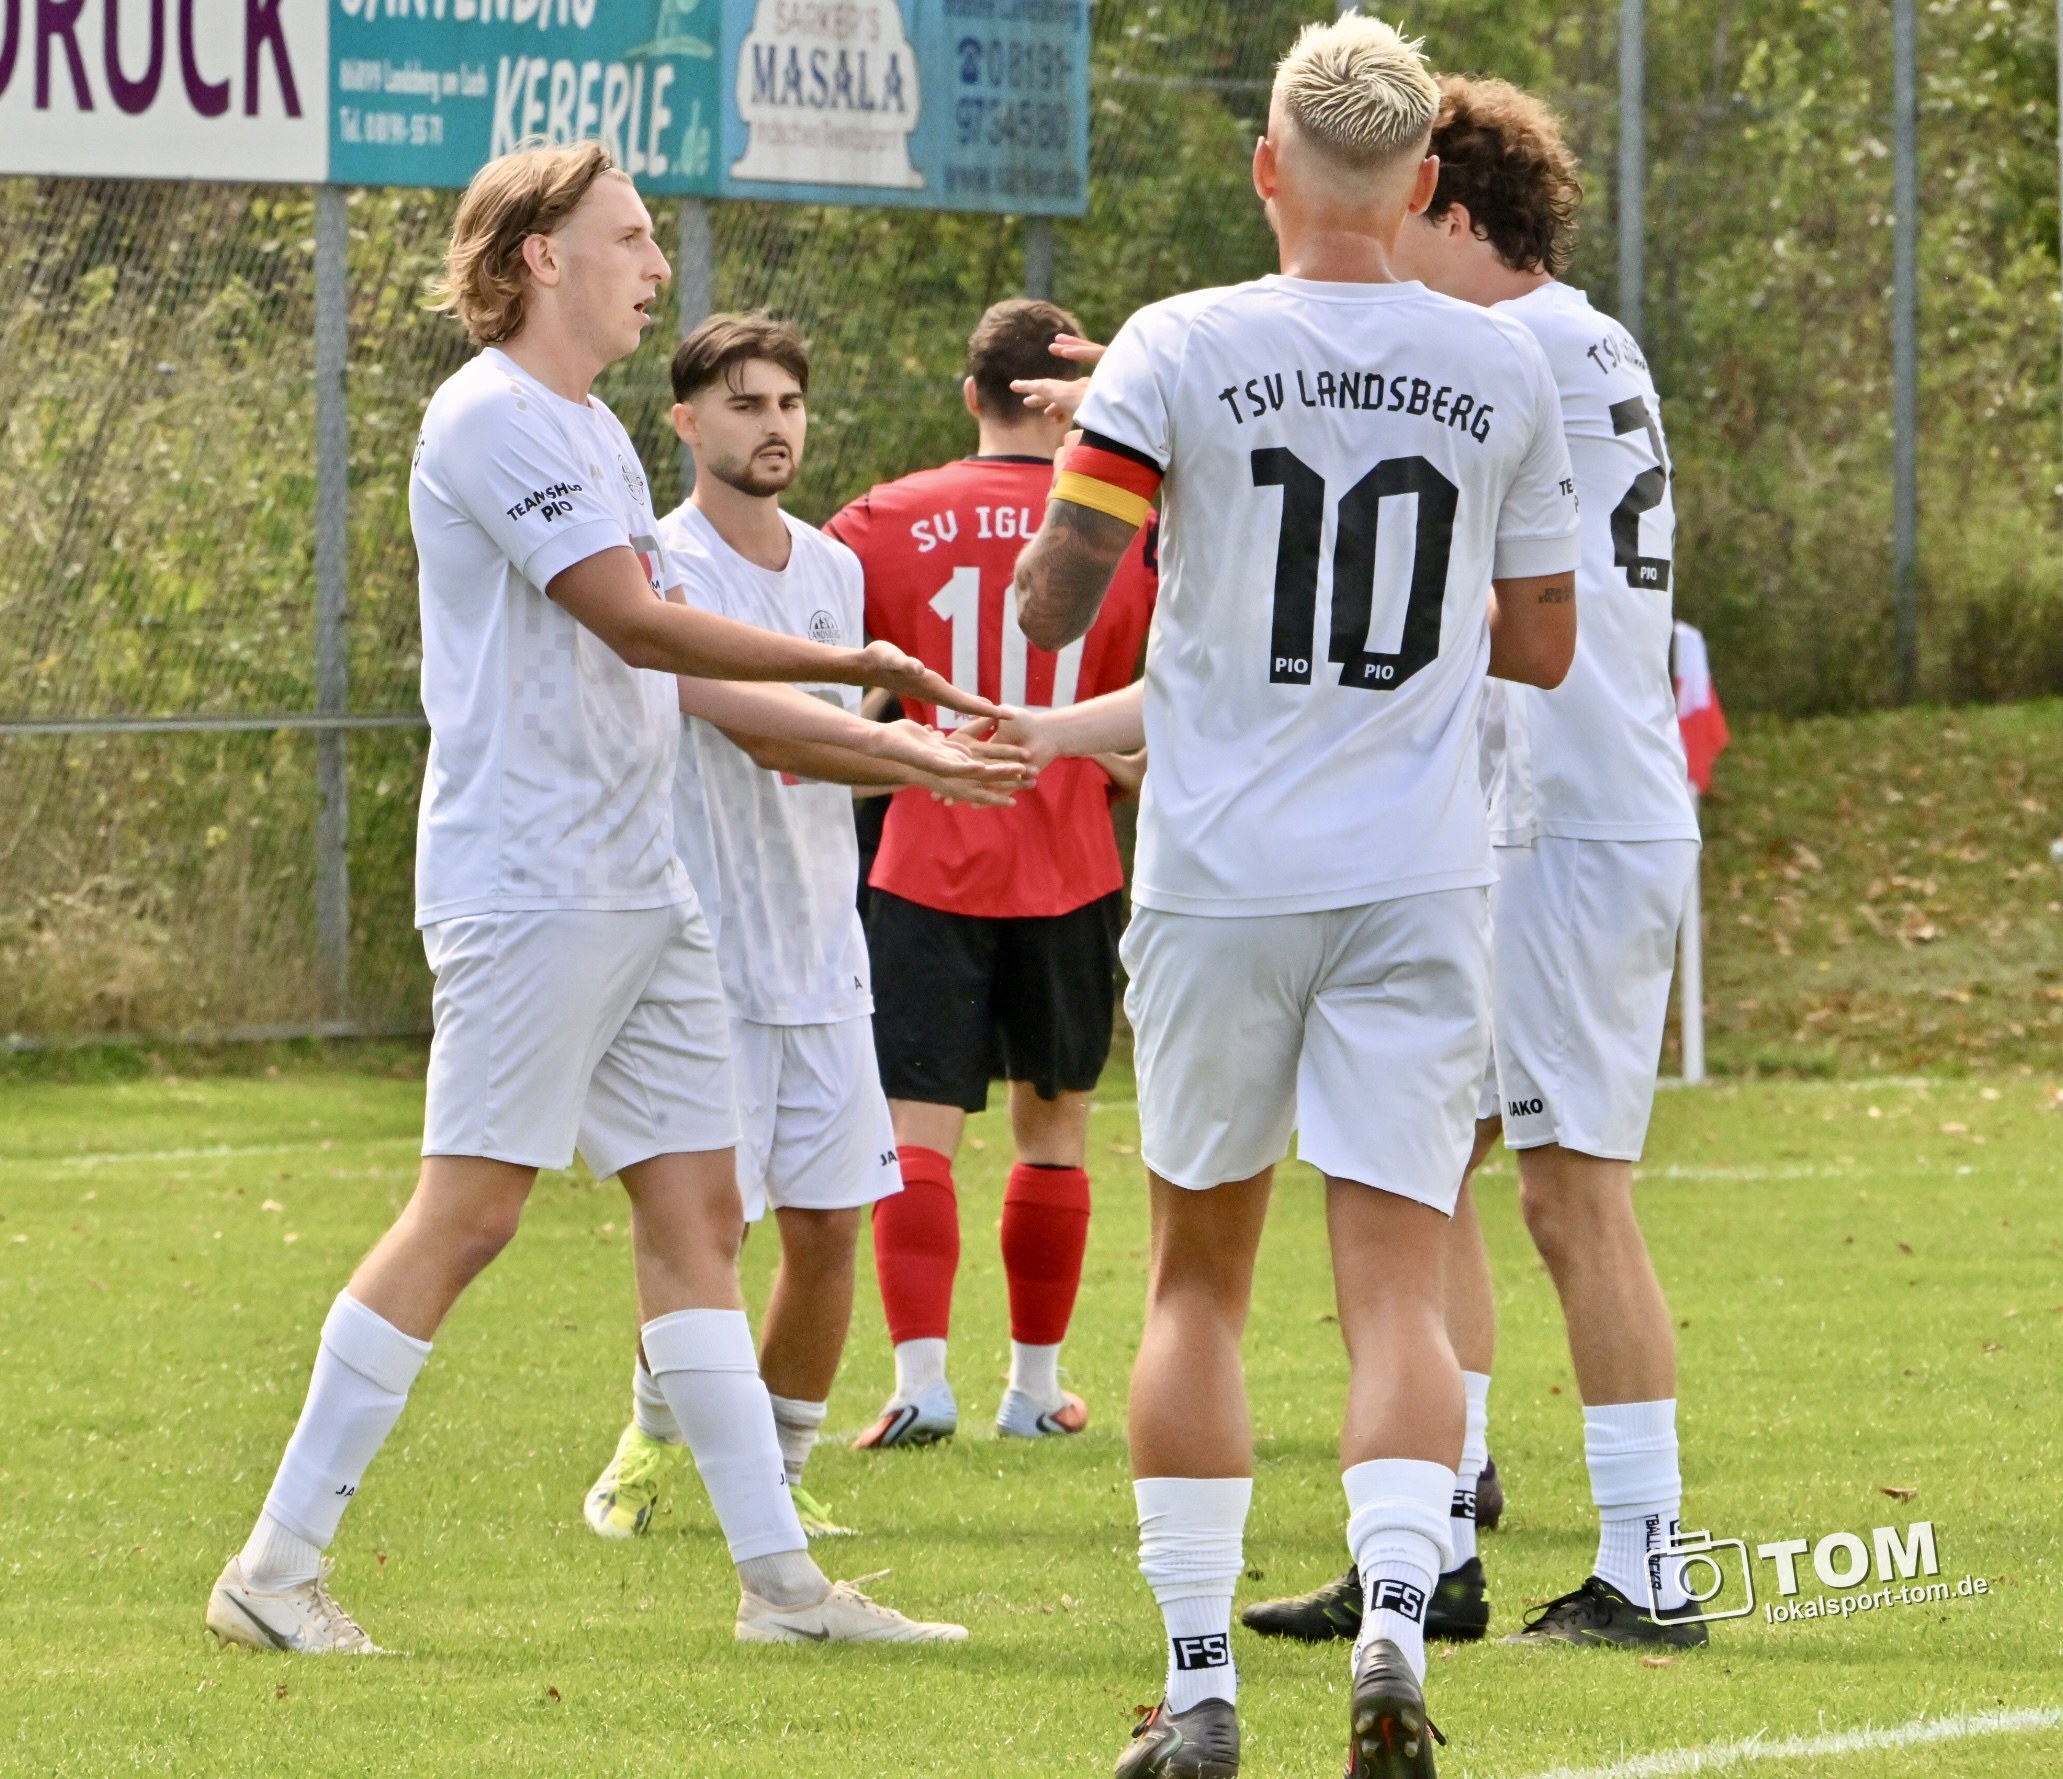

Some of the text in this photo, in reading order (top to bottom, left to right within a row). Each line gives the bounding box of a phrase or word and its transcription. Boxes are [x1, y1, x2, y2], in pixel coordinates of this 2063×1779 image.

[752, 43, 905, 112] MASALA
[1218, 370, 1494, 443] TSV LANDSBERG
[541, 500, 573, 522] PIO
[1250, 446, 1459, 691] 10
[1275, 657, 1308, 675] PIO
[1363, 663, 1394, 681] PIO
[1375, 1580, 1425, 1621] FS
[1178, 1636, 1228, 1669] FS
